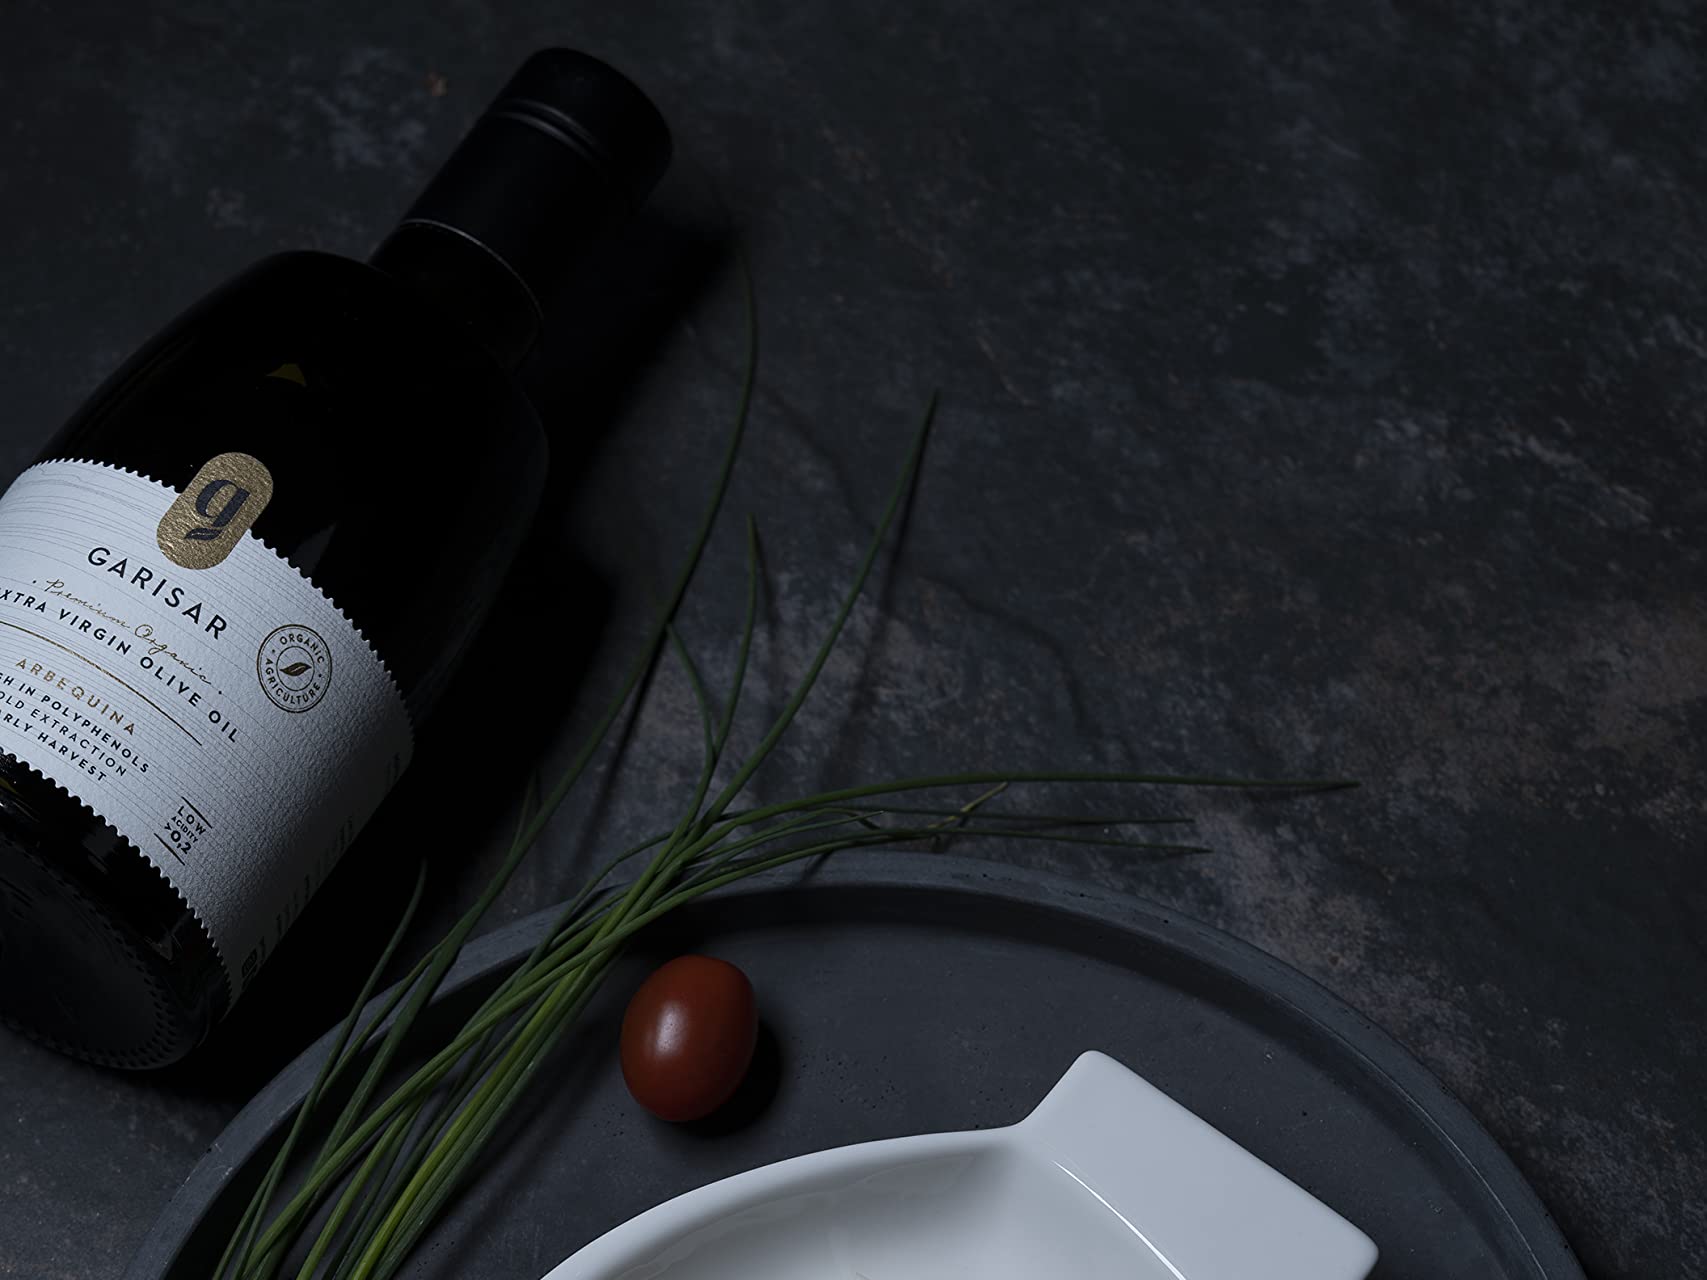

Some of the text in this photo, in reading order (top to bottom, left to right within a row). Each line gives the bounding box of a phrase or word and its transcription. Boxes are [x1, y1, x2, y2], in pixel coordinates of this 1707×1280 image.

[88, 547, 227, 640] GARISAR
[0, 588, 238, 743] XTRA VIRGIN OLIVE OIL
[46, 578, 211, 686] Premium Organic
[280, 633, 325, 664] ORGANIC
[16, 658, 135, 736] ARBEQUINA
[265, 657, 321, 704] AGRICULTURE
[0, 709, 107, 782] RLY HARVEST
[19, 683, 149, 773] IN POLYPHENOLS
[30, 708, 127, 777] EXTRACTION
[171, 816, 198, 843] ACIDITY
[178, 806, 206, 835] LOW
